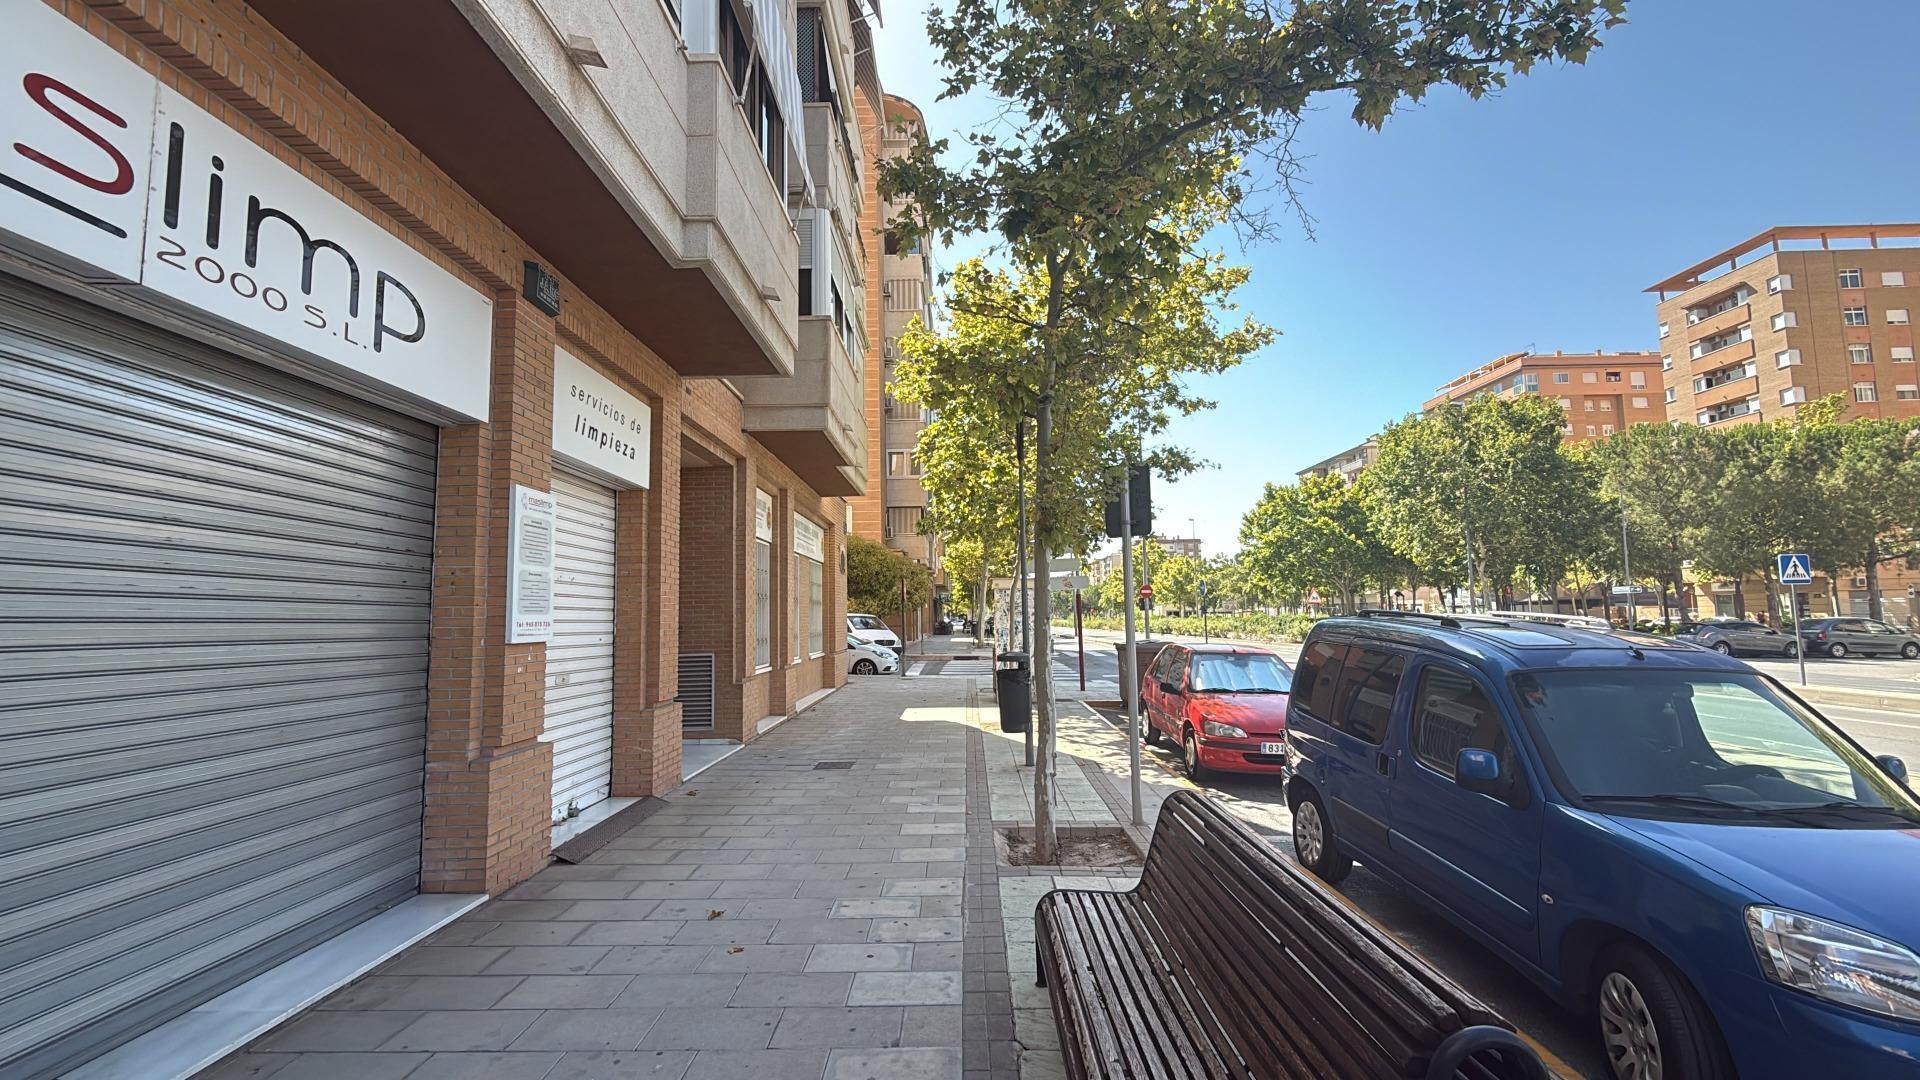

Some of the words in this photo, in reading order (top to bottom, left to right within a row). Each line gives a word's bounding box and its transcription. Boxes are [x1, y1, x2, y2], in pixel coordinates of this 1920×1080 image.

[156, 235, 288, 312] 2000
[303, 304, 368, 350] S.L.
[570, 384, 625, 426] servicios
[630, 418, 642, 435] de
[574, 413, 636, 460] limpieza
